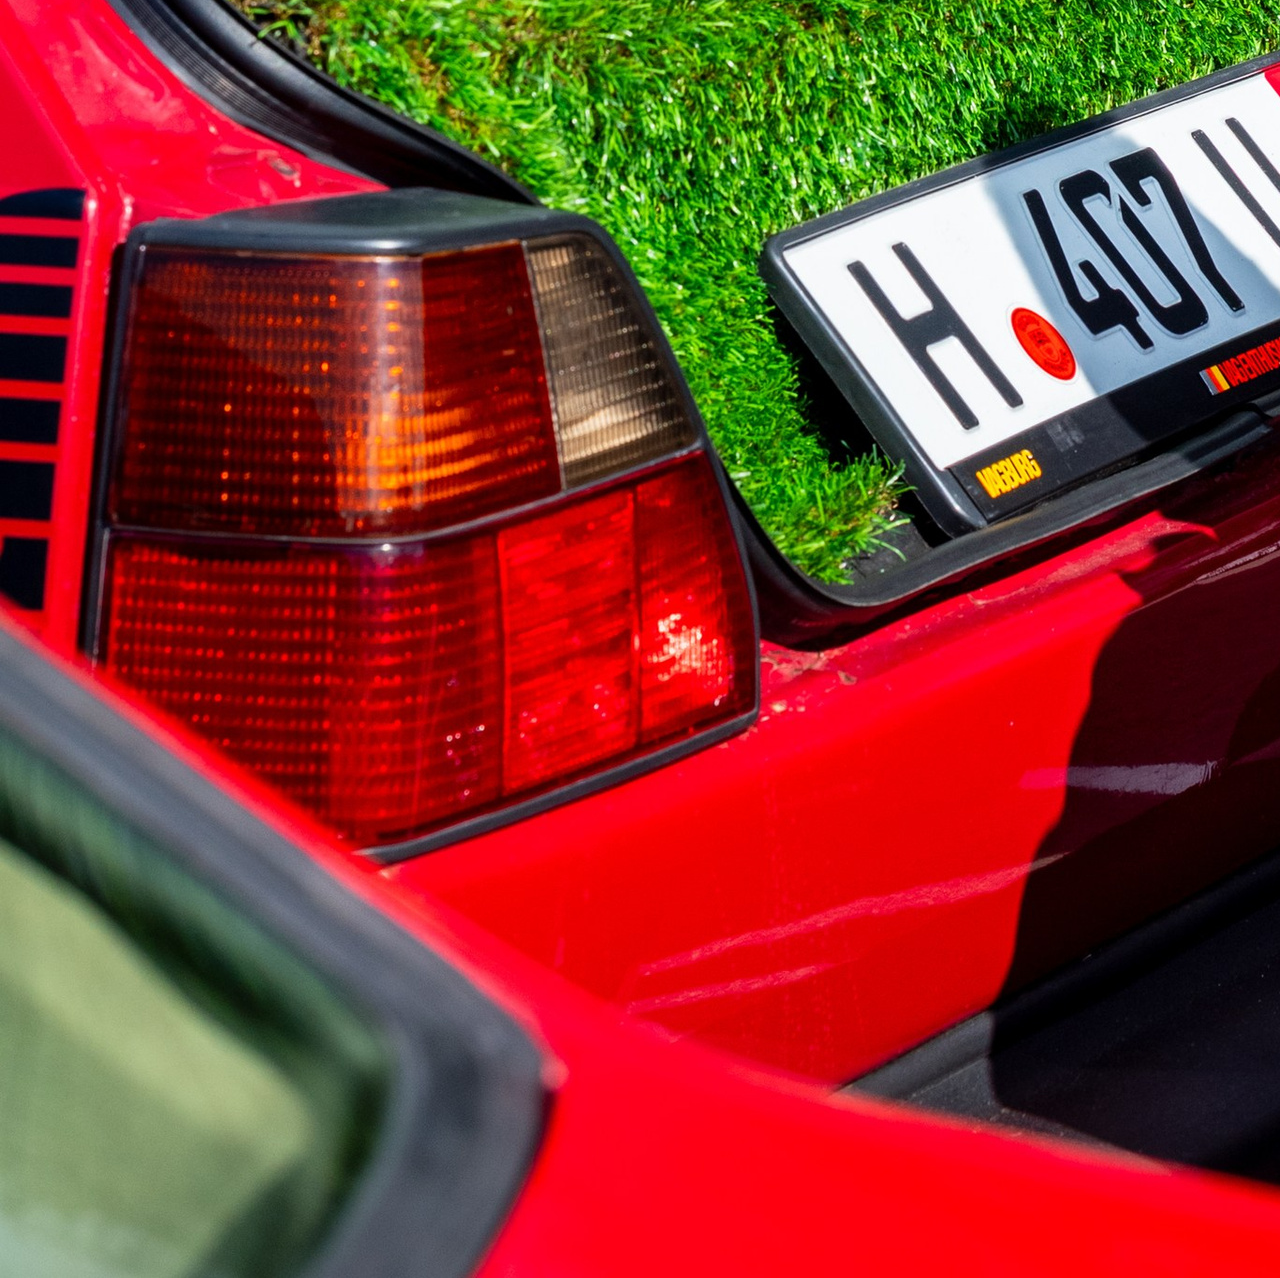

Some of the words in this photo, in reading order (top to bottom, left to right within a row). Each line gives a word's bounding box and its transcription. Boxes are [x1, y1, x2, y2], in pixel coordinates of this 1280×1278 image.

[847, 241, 1024, 430] H
[1023, 146, 1246, 350] 407
[975, 449, 1042, 498] VAGBURG
